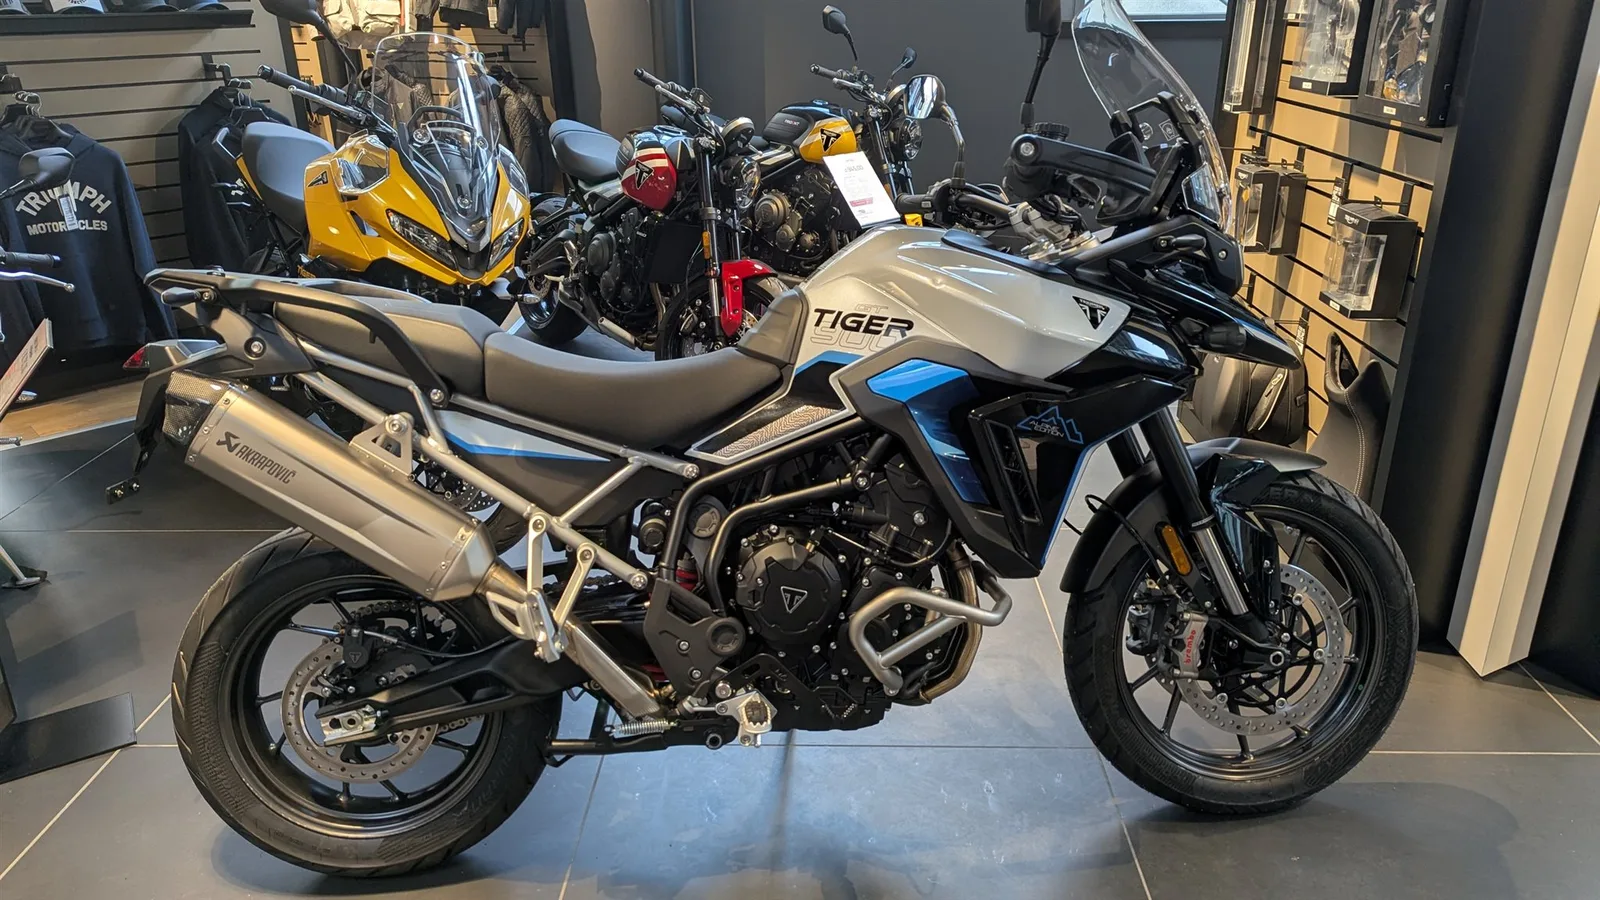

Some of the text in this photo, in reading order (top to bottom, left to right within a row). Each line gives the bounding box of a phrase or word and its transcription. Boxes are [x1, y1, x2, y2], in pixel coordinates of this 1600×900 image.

[26, 219, 108, 236] MOTORCLES
[814, 308, 915, 338] TIGER
[1033, 425, 1065, 438] EDITION
[1184, 629, 1197, 664] brembo
